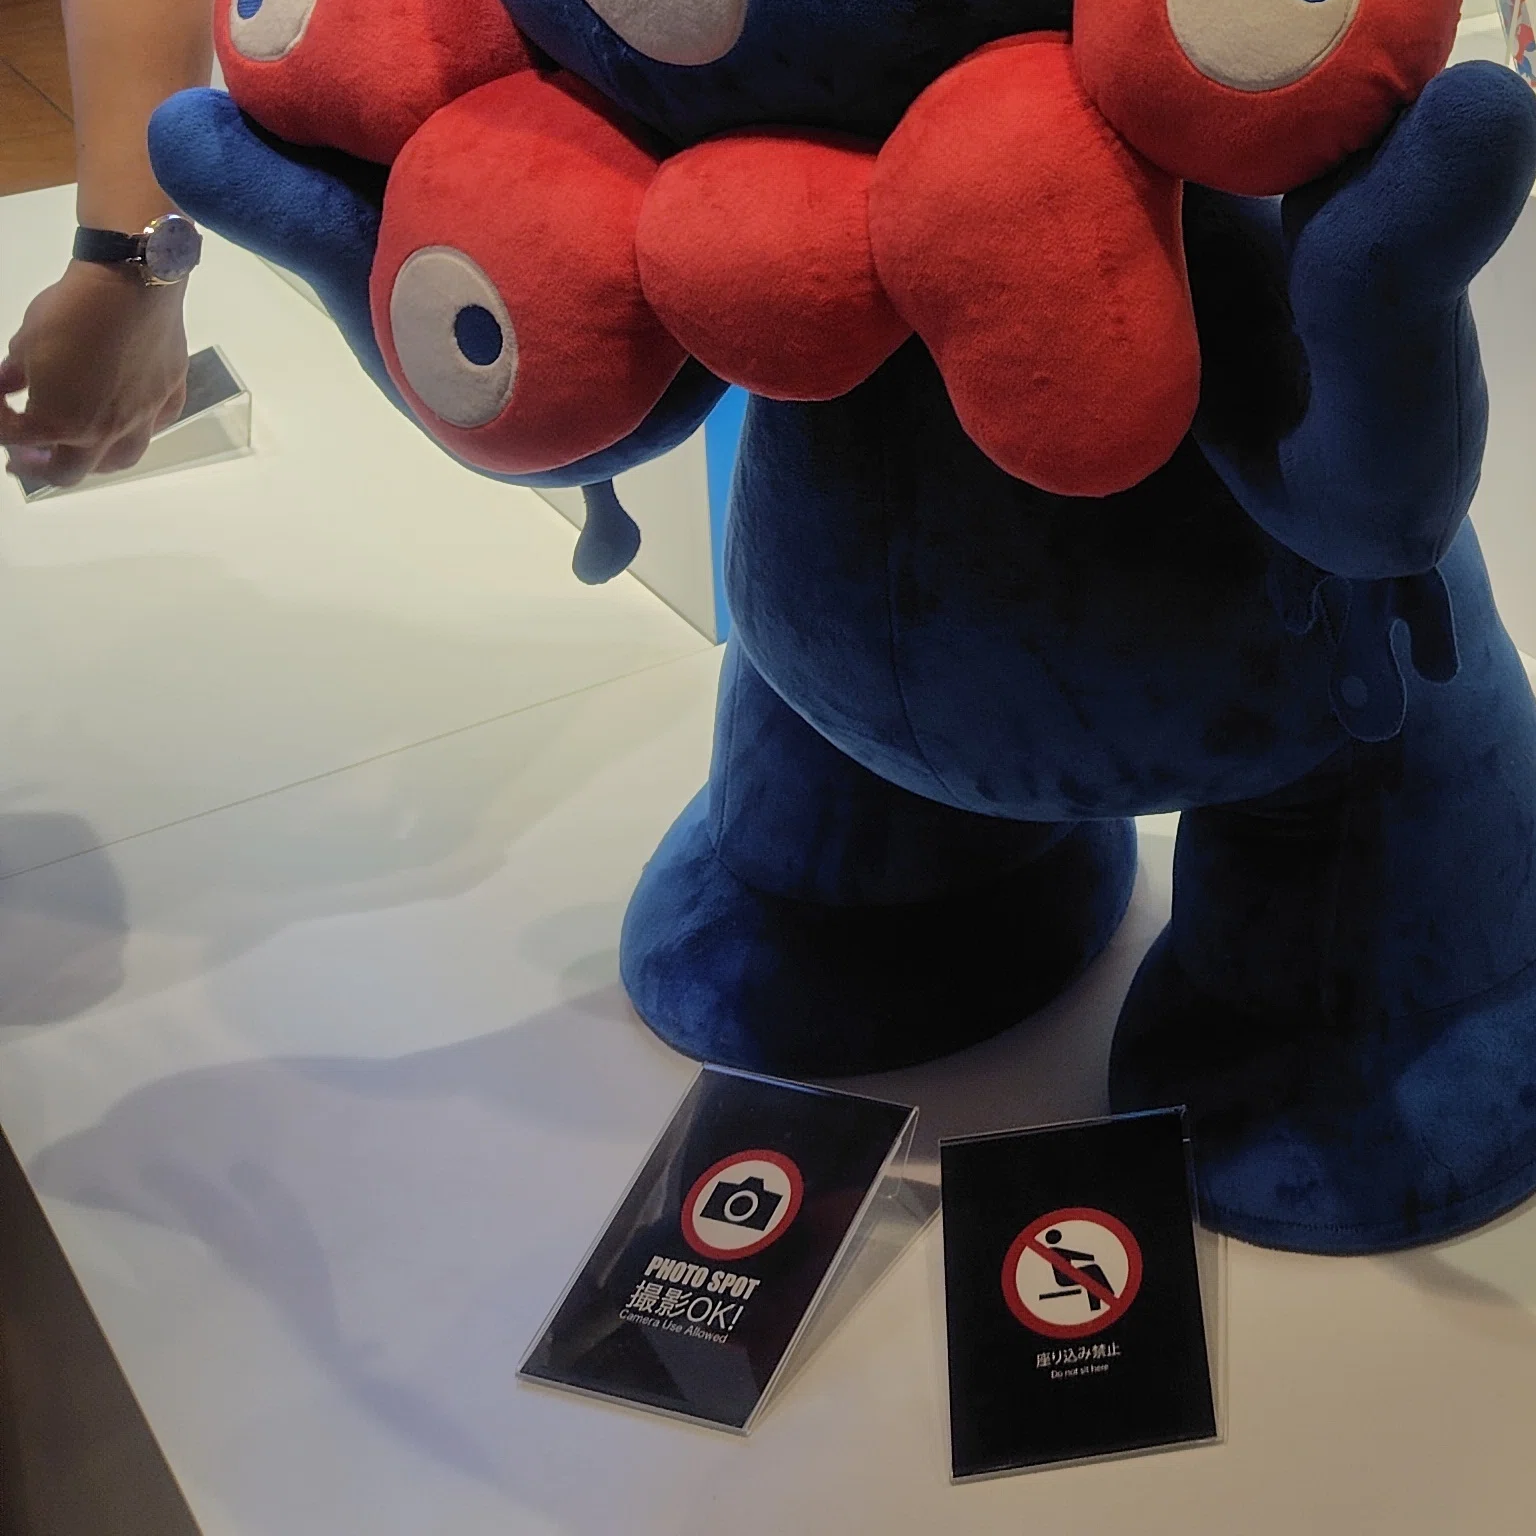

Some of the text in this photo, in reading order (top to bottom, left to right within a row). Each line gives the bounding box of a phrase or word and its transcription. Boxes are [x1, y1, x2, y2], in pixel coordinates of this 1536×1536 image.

[644, 1255, 761, 1300] PHOTO SPOT
[619, 1308, 729, 1344] Camera Use Allowed
[1036, 1341, 1122, 1369] 座り込み禁止
[1051, 1363, 1110, 1379] Do not sit here
